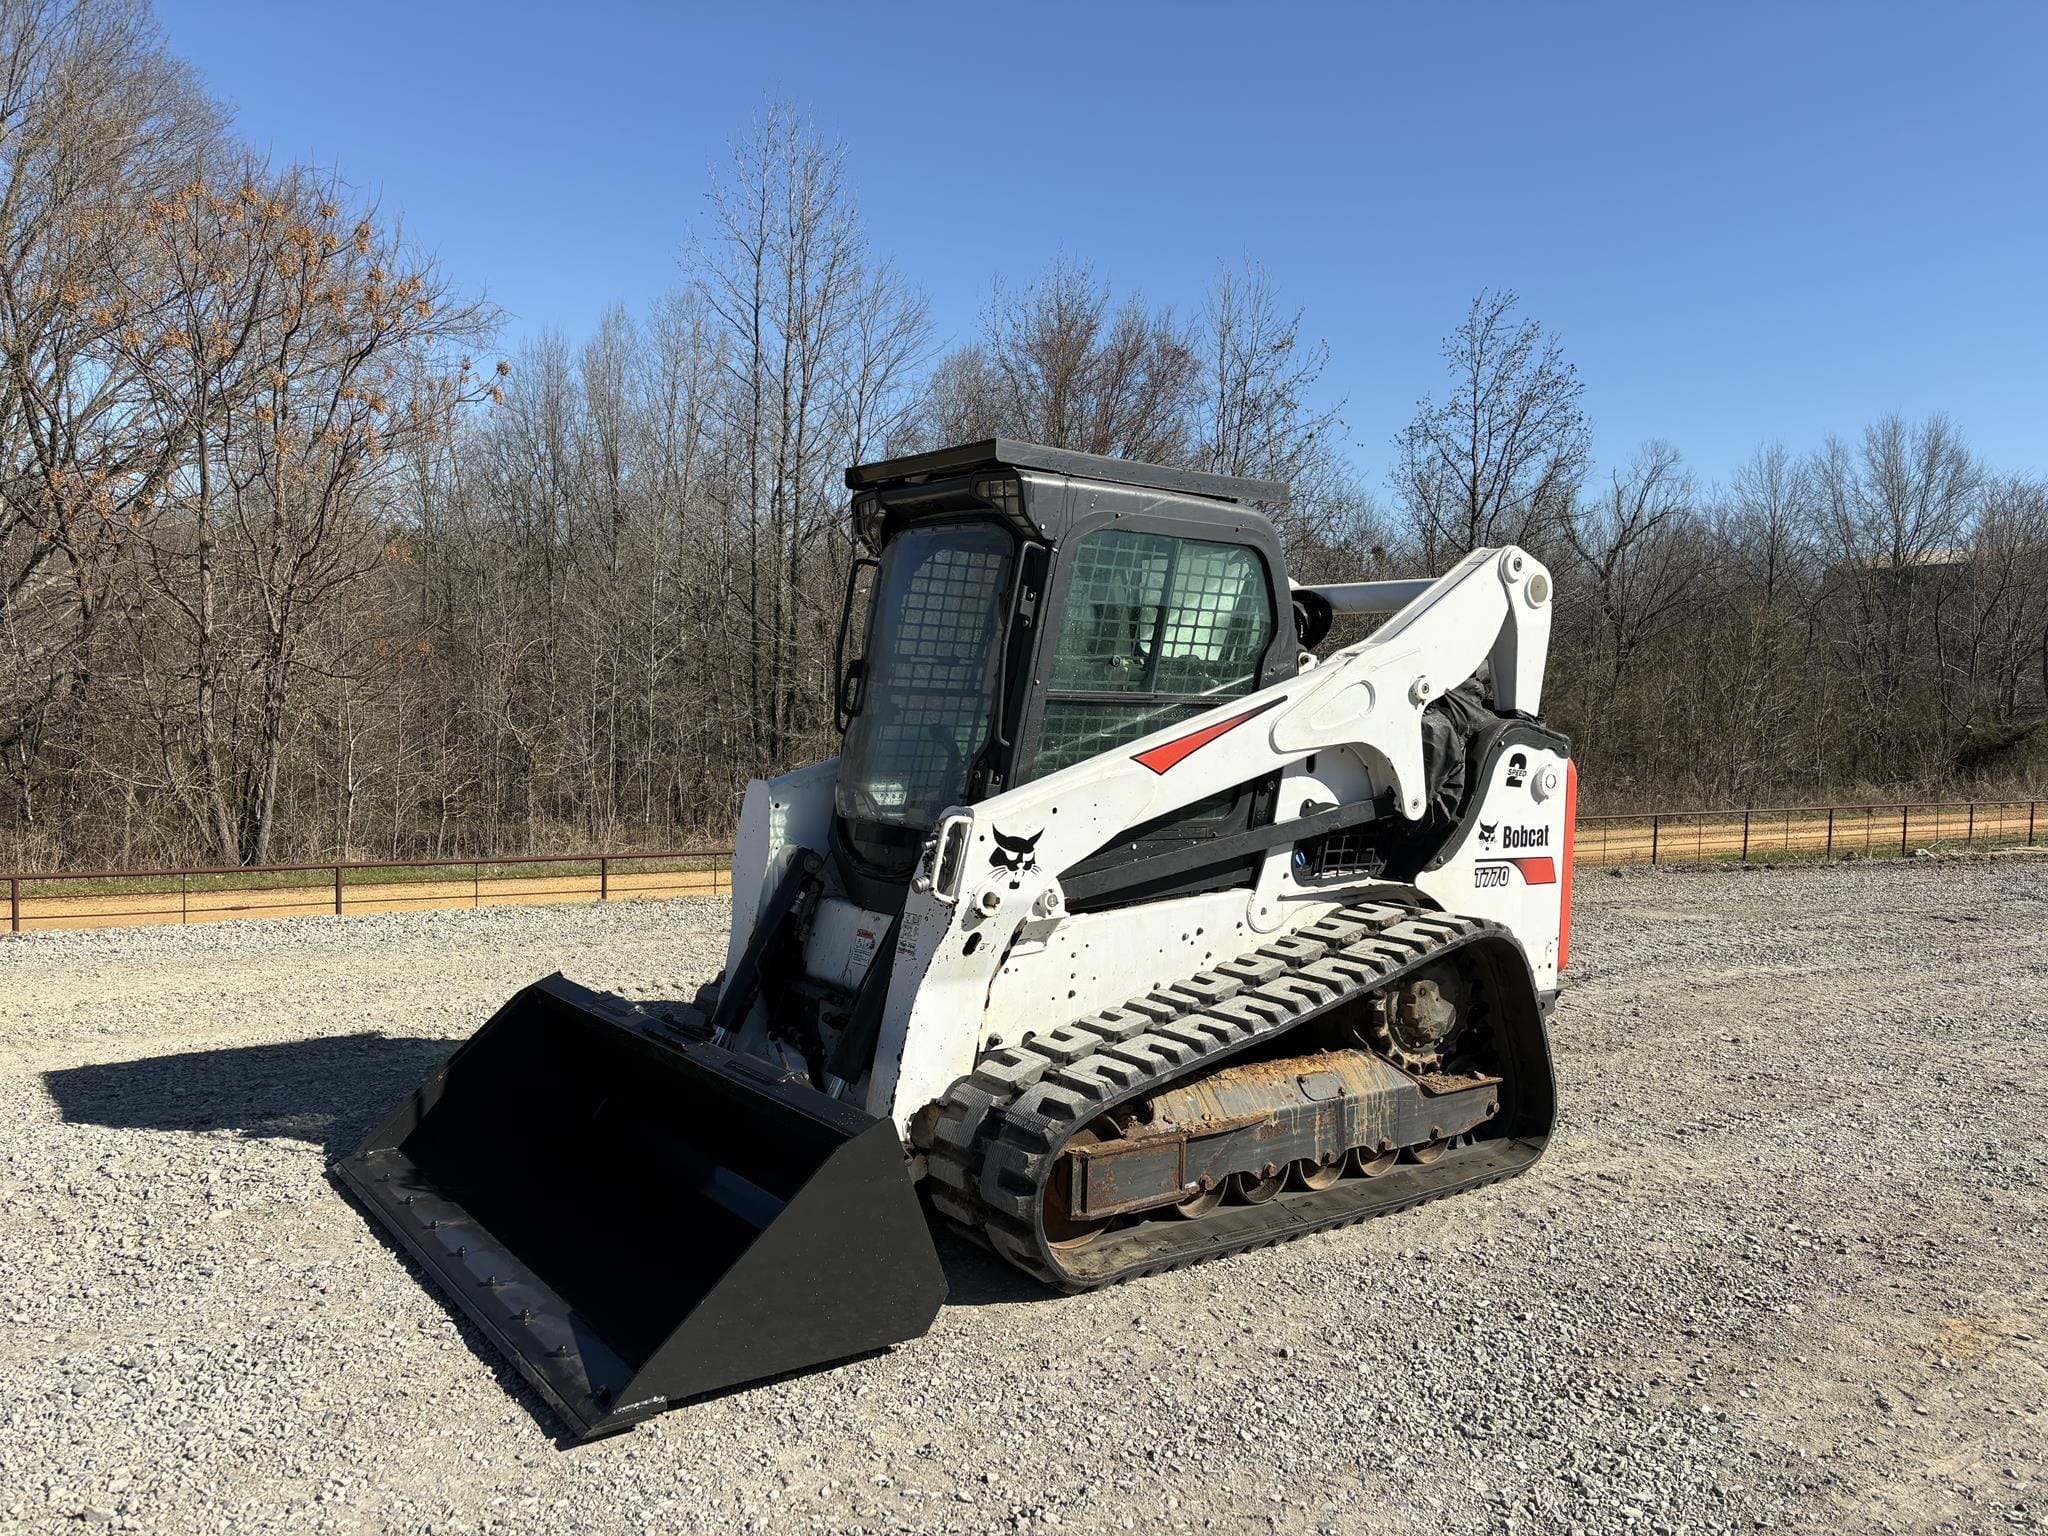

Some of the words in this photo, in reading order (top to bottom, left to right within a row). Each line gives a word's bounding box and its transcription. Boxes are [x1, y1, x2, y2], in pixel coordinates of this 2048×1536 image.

[1506, 753, 1527, 787] 2
[1507, 768, 1527, 777] SPEED
[1503, 825, 1549, 848] Bobcat
[1475, 866, 1509, 888] T770
